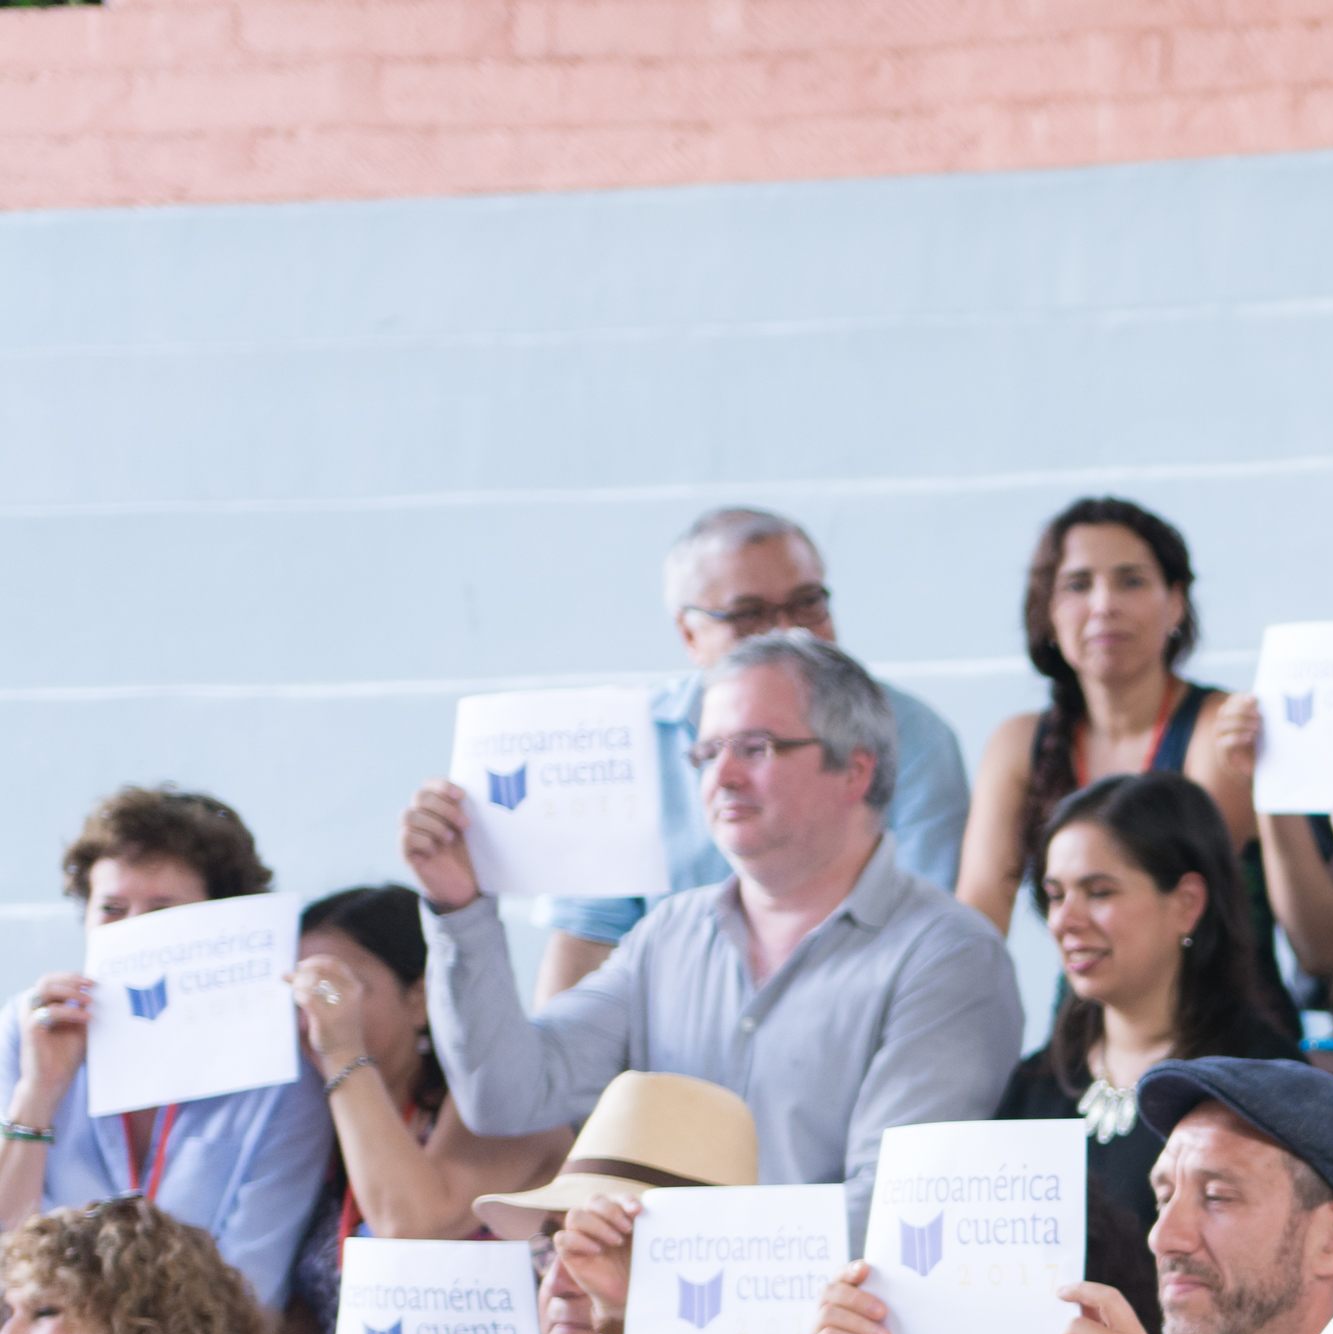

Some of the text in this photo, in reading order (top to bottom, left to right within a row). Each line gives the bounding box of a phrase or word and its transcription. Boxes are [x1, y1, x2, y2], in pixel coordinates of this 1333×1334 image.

[541, 758, 634, 788] cuenta
[180, 958, 271, 994] cuenta
[882, 1163, 1062, 1204] centroamérica
[649, 1226, 830, 1262] centroamérica
[957, 1212, 1062, 1245] cuenta
[958, 1264, 1059, 1296] 2017
